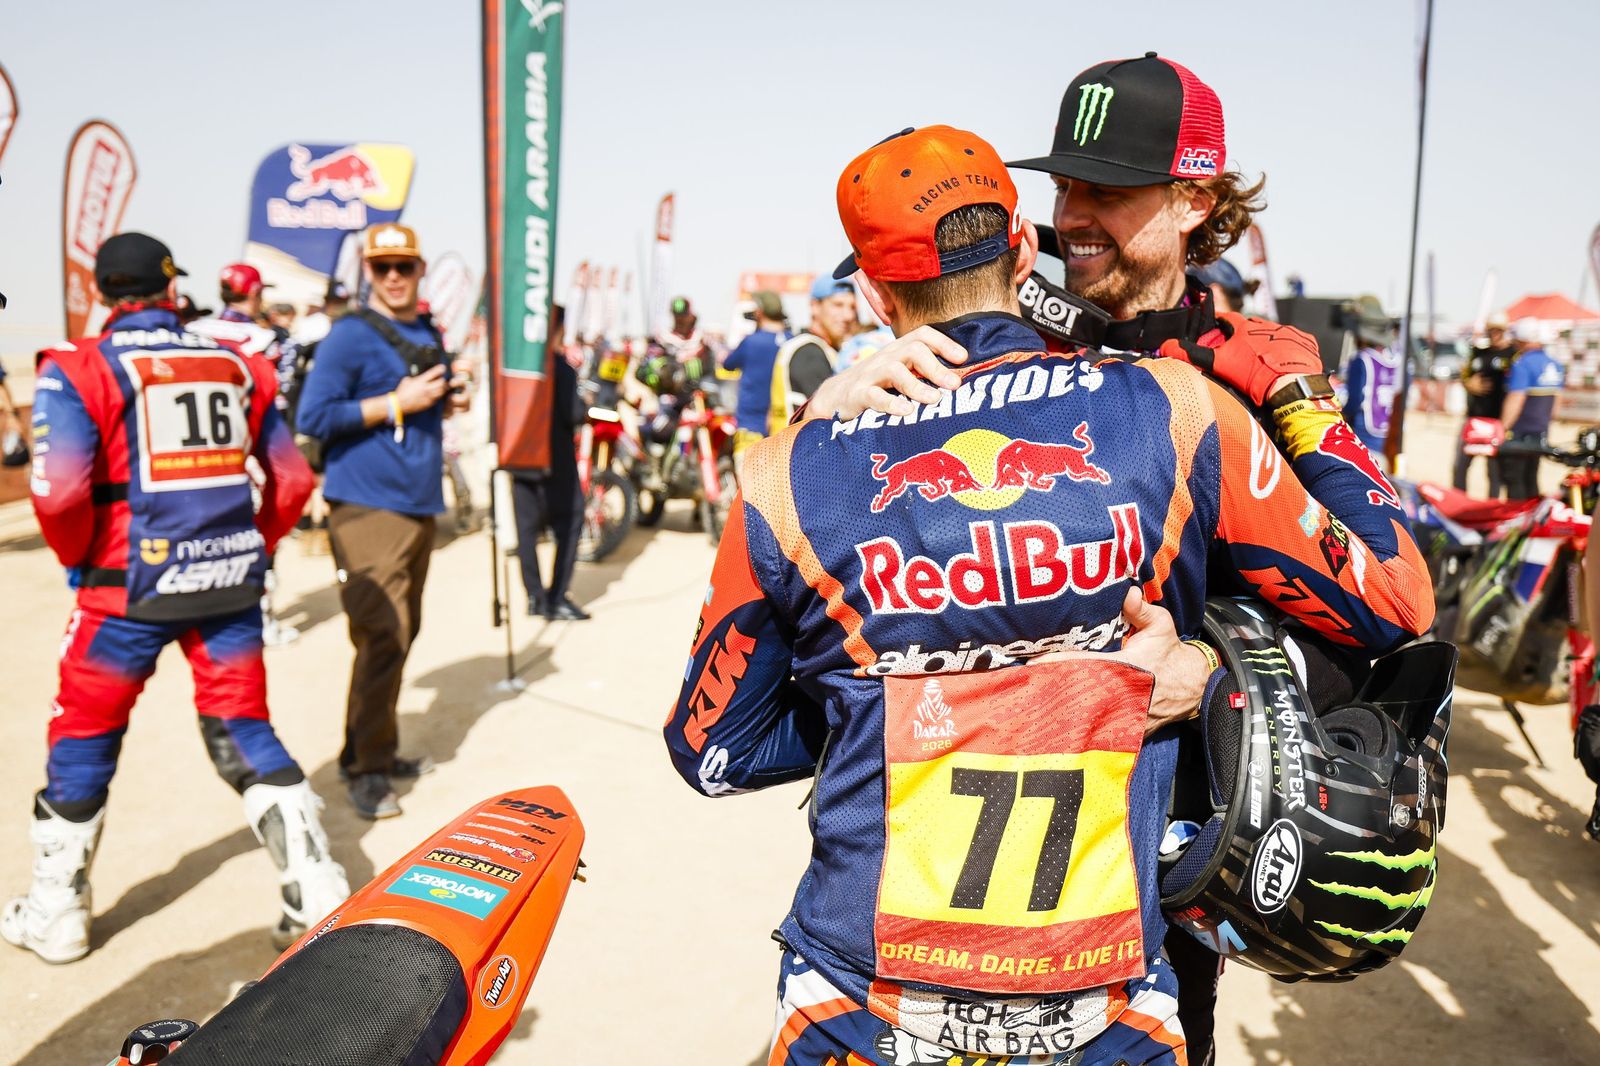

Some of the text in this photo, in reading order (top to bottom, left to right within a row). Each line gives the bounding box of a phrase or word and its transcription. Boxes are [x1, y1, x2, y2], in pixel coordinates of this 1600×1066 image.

[1179, 147, 1218, 170] HRC
[524, 51, 549, 343] SAUDI ARABIA
[913, 174, 999, 213] RACING TEAM
[1018, 277, 1083, 329] BLOT
[174, 391, 232, 447] 16
[854, 502, 1145, 616] Red Bull
[683, 621, 758, 755] KTM
[913, 719, 960, 740] DAKAR
[921, 739, 953, 752] 2026
[1265, 705, 1282, 791] ENERGY
[1273, 689, 1307, 812] MONSTER
[495, 797, 569, 820] KTM
[949, 767, 1084, 913] 77
[1261, 824, 1297, 904] Arai
[405, 872, 496, 904] MOTOREX
[426, 851, 519, 882] HINSON
[880, 938, 1142, 976] DREAM. DARE. LIVE IT.
[484, 958, 513, 1006] Twin Air
[1005, 1027, 1076, 1054] BAG
